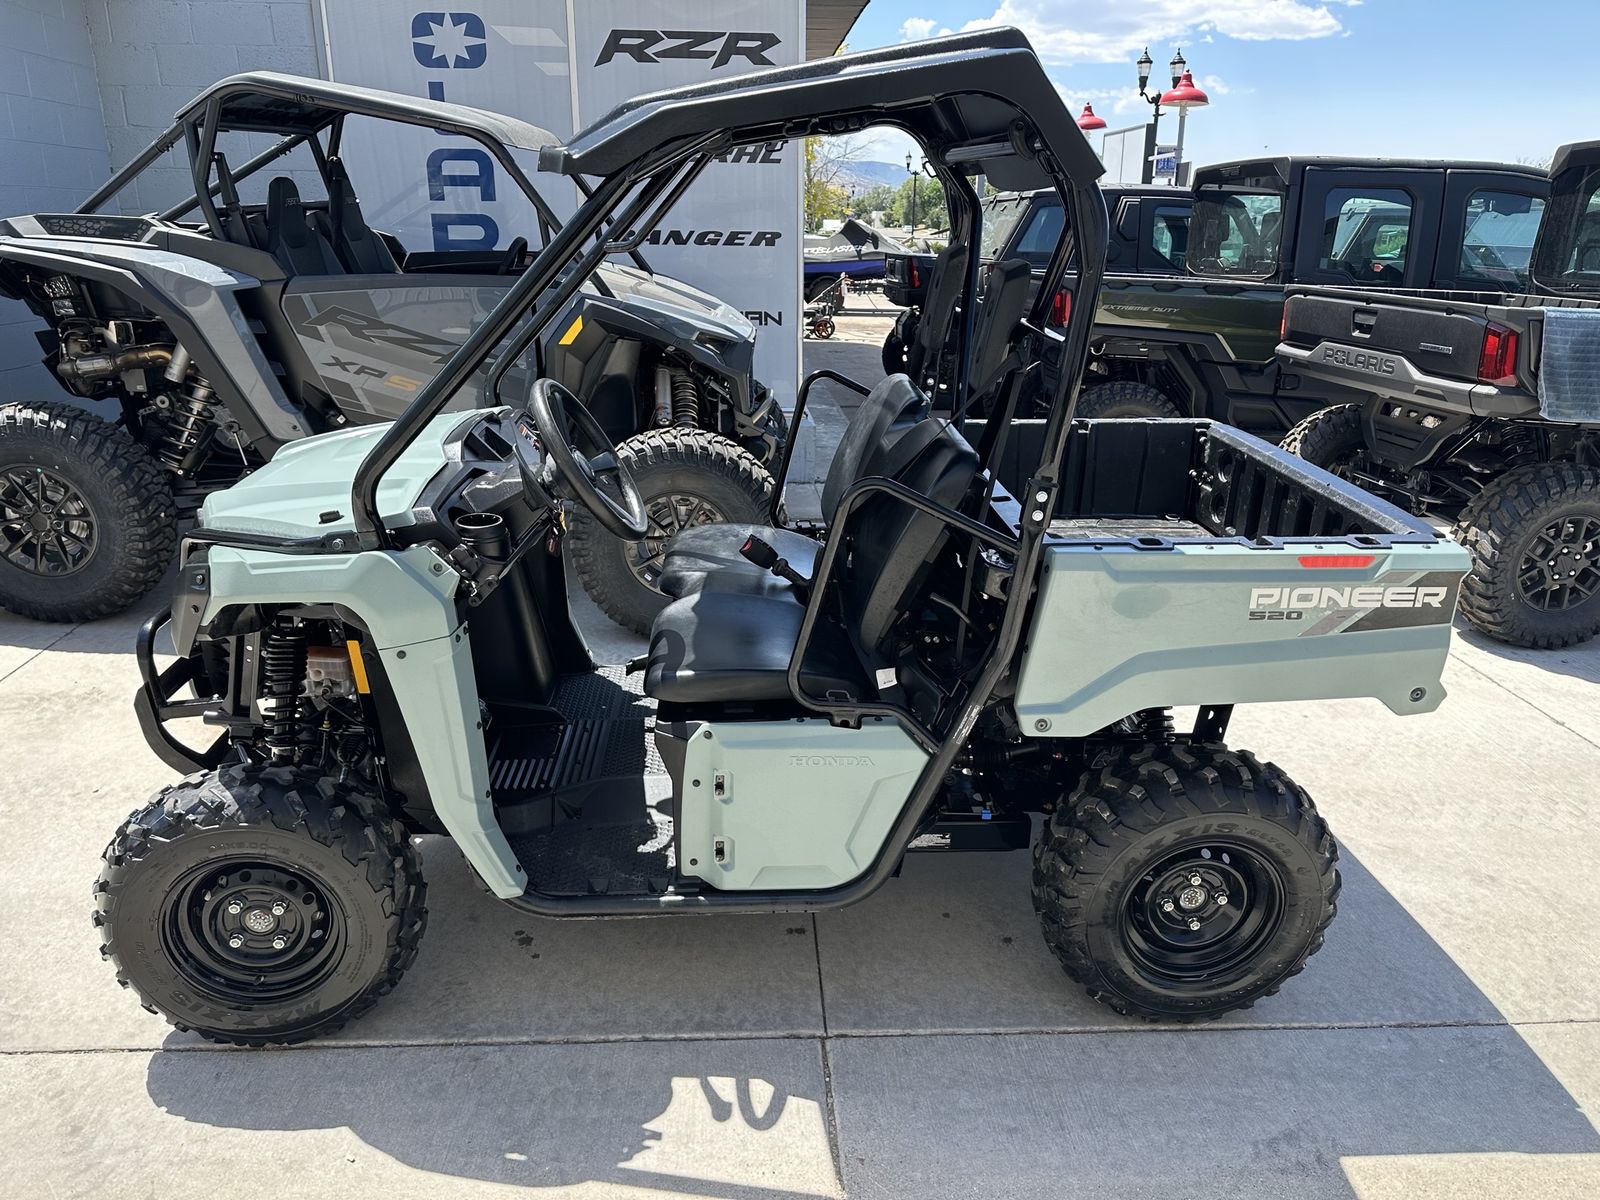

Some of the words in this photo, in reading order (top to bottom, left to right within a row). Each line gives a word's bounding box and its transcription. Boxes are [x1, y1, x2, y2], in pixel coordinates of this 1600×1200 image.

[593, 29, 782, 69] RZR
[1101, 304, 1151, 312] EXTREME
[1322, 347, 1396, 375] POLARIS
[1249, 586, 1448, 609] PIONEER
[1248, 610, 1303, 621] 520
[789, 755, 877, 768] HONDA
